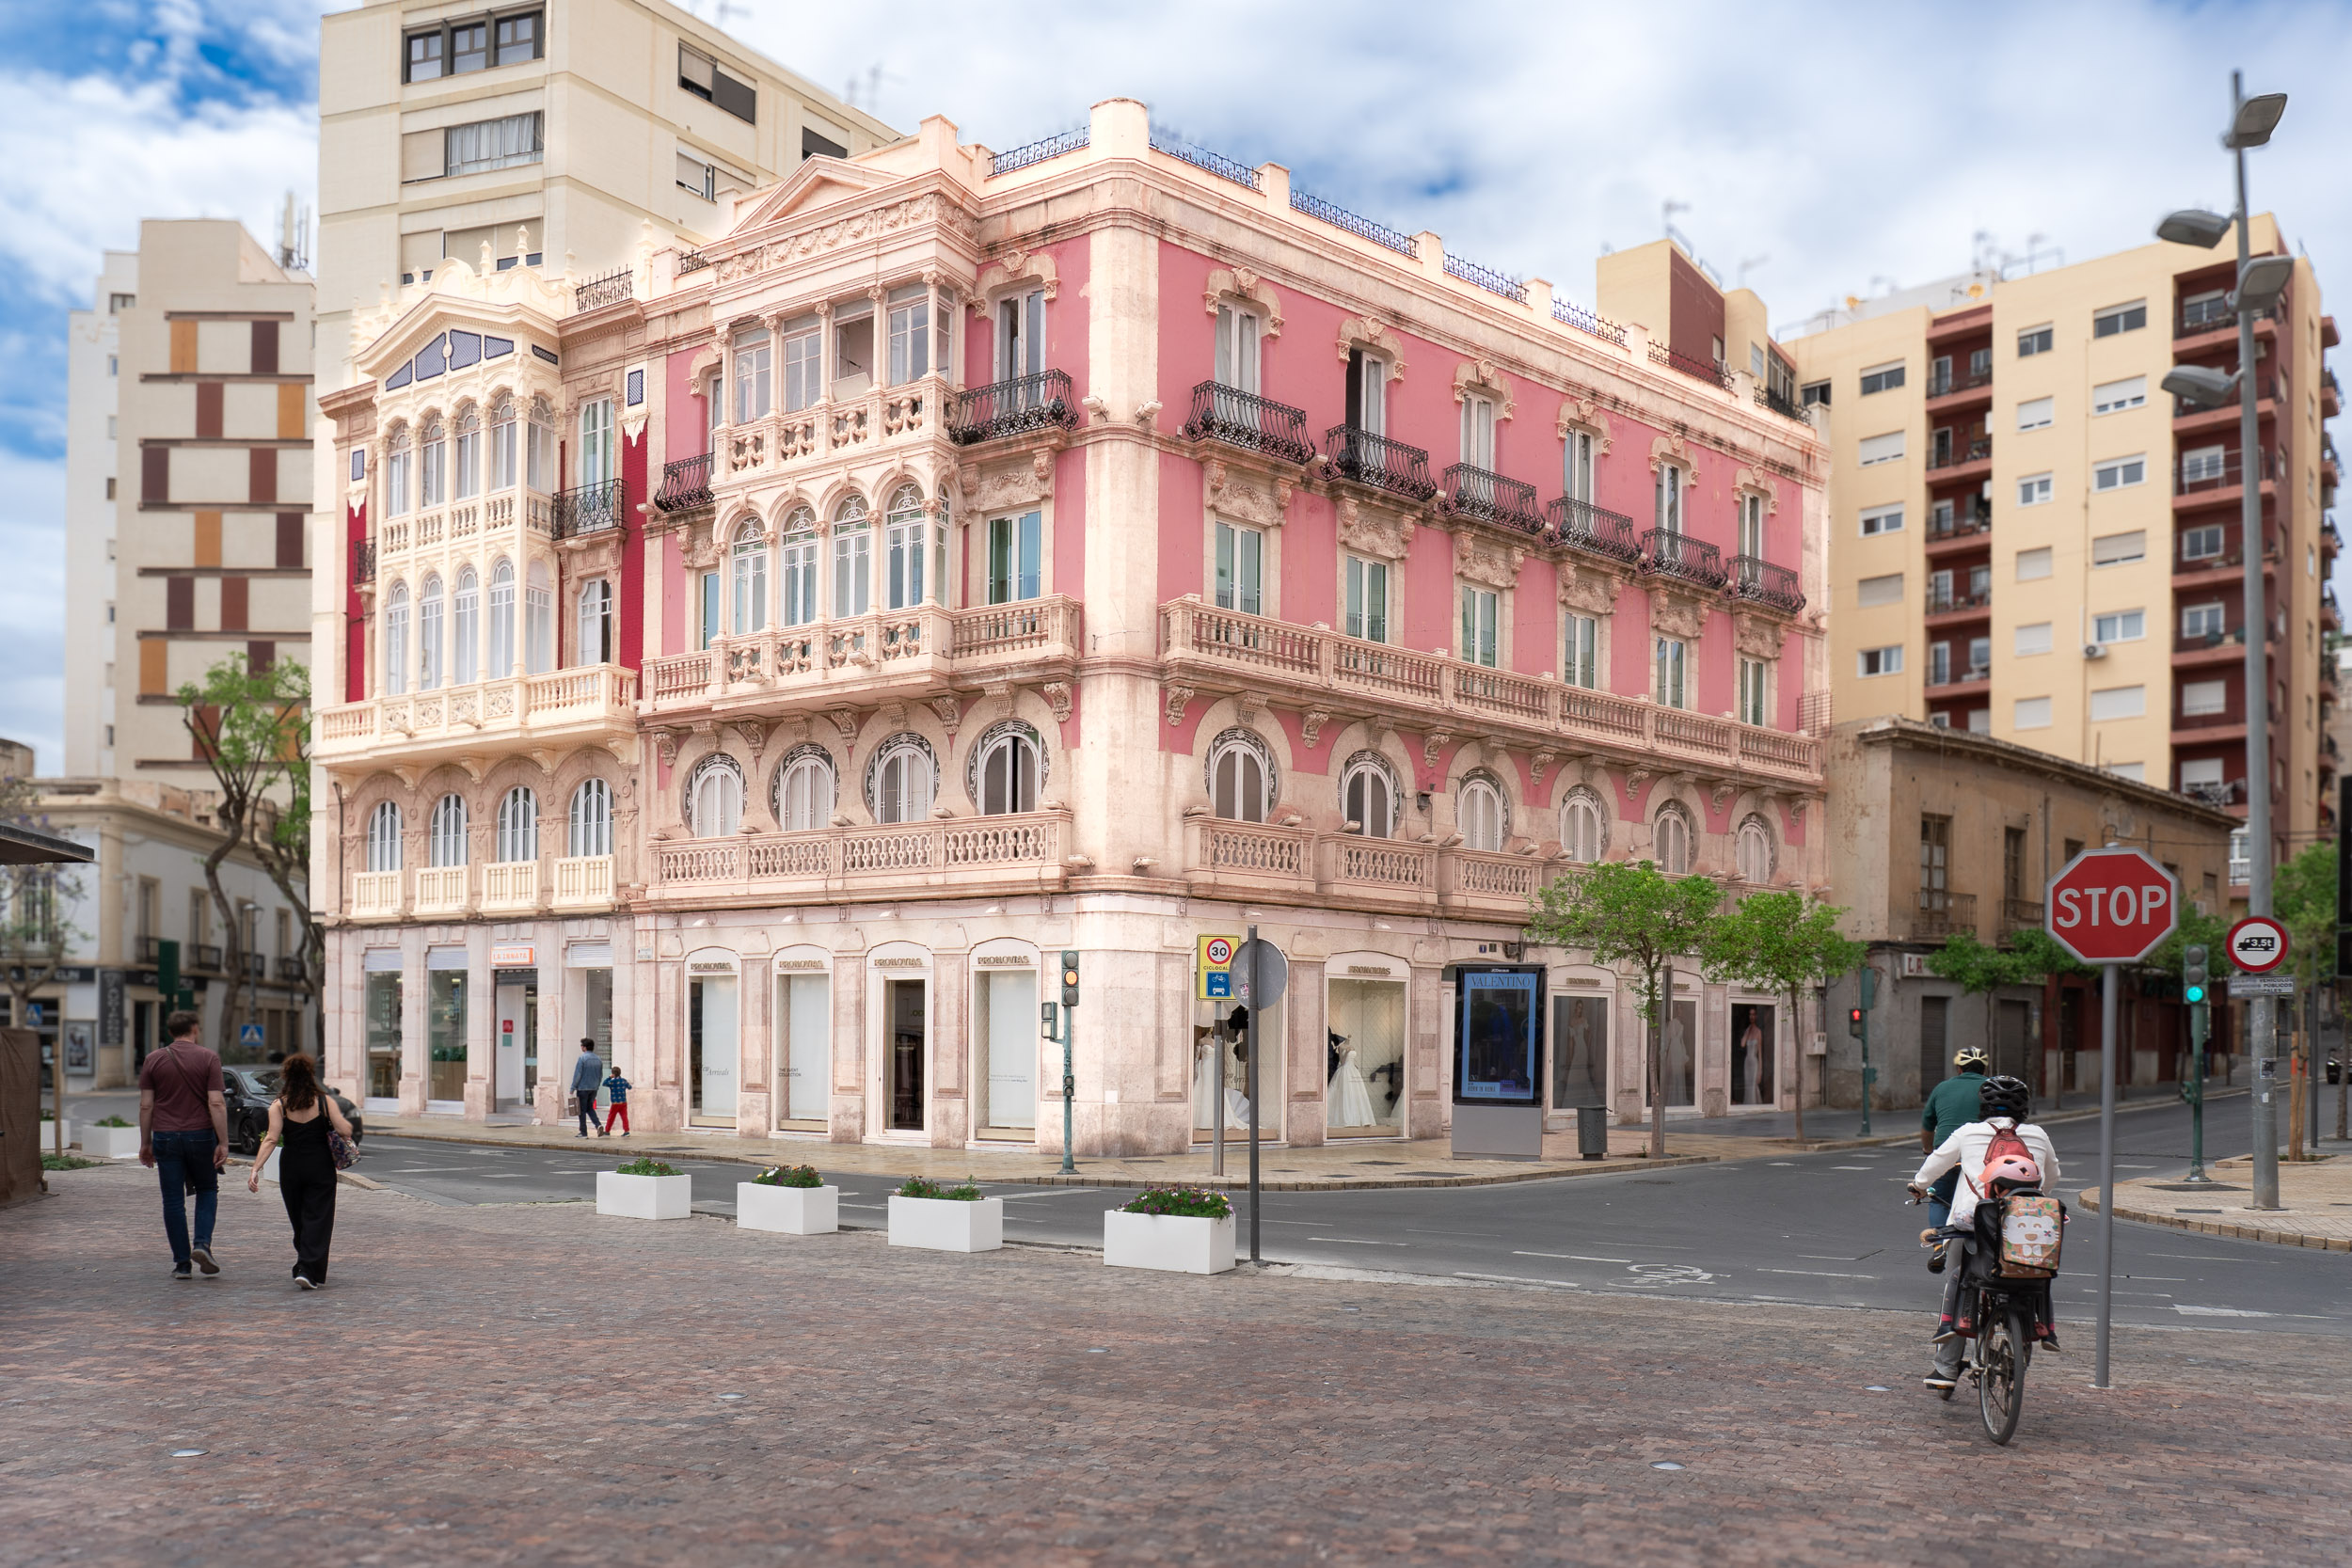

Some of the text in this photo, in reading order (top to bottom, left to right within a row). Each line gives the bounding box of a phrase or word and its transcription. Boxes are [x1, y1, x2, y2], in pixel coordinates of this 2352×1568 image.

[2056, 885, 2167, 927] STOP
[1211, 946, 1227, 957] 30
[779, 960, 824, 969] PRONOVIAS
[874, 958, 923, 966] PRONOVIAS
[977, 956, 1030, 964] PRONOVIAS
[1347, 965, 1391, 974] PRONOVIAS
[1908, 957, 1923, 974] LA
[1471, 976, 1531, 987] VALENTINO
